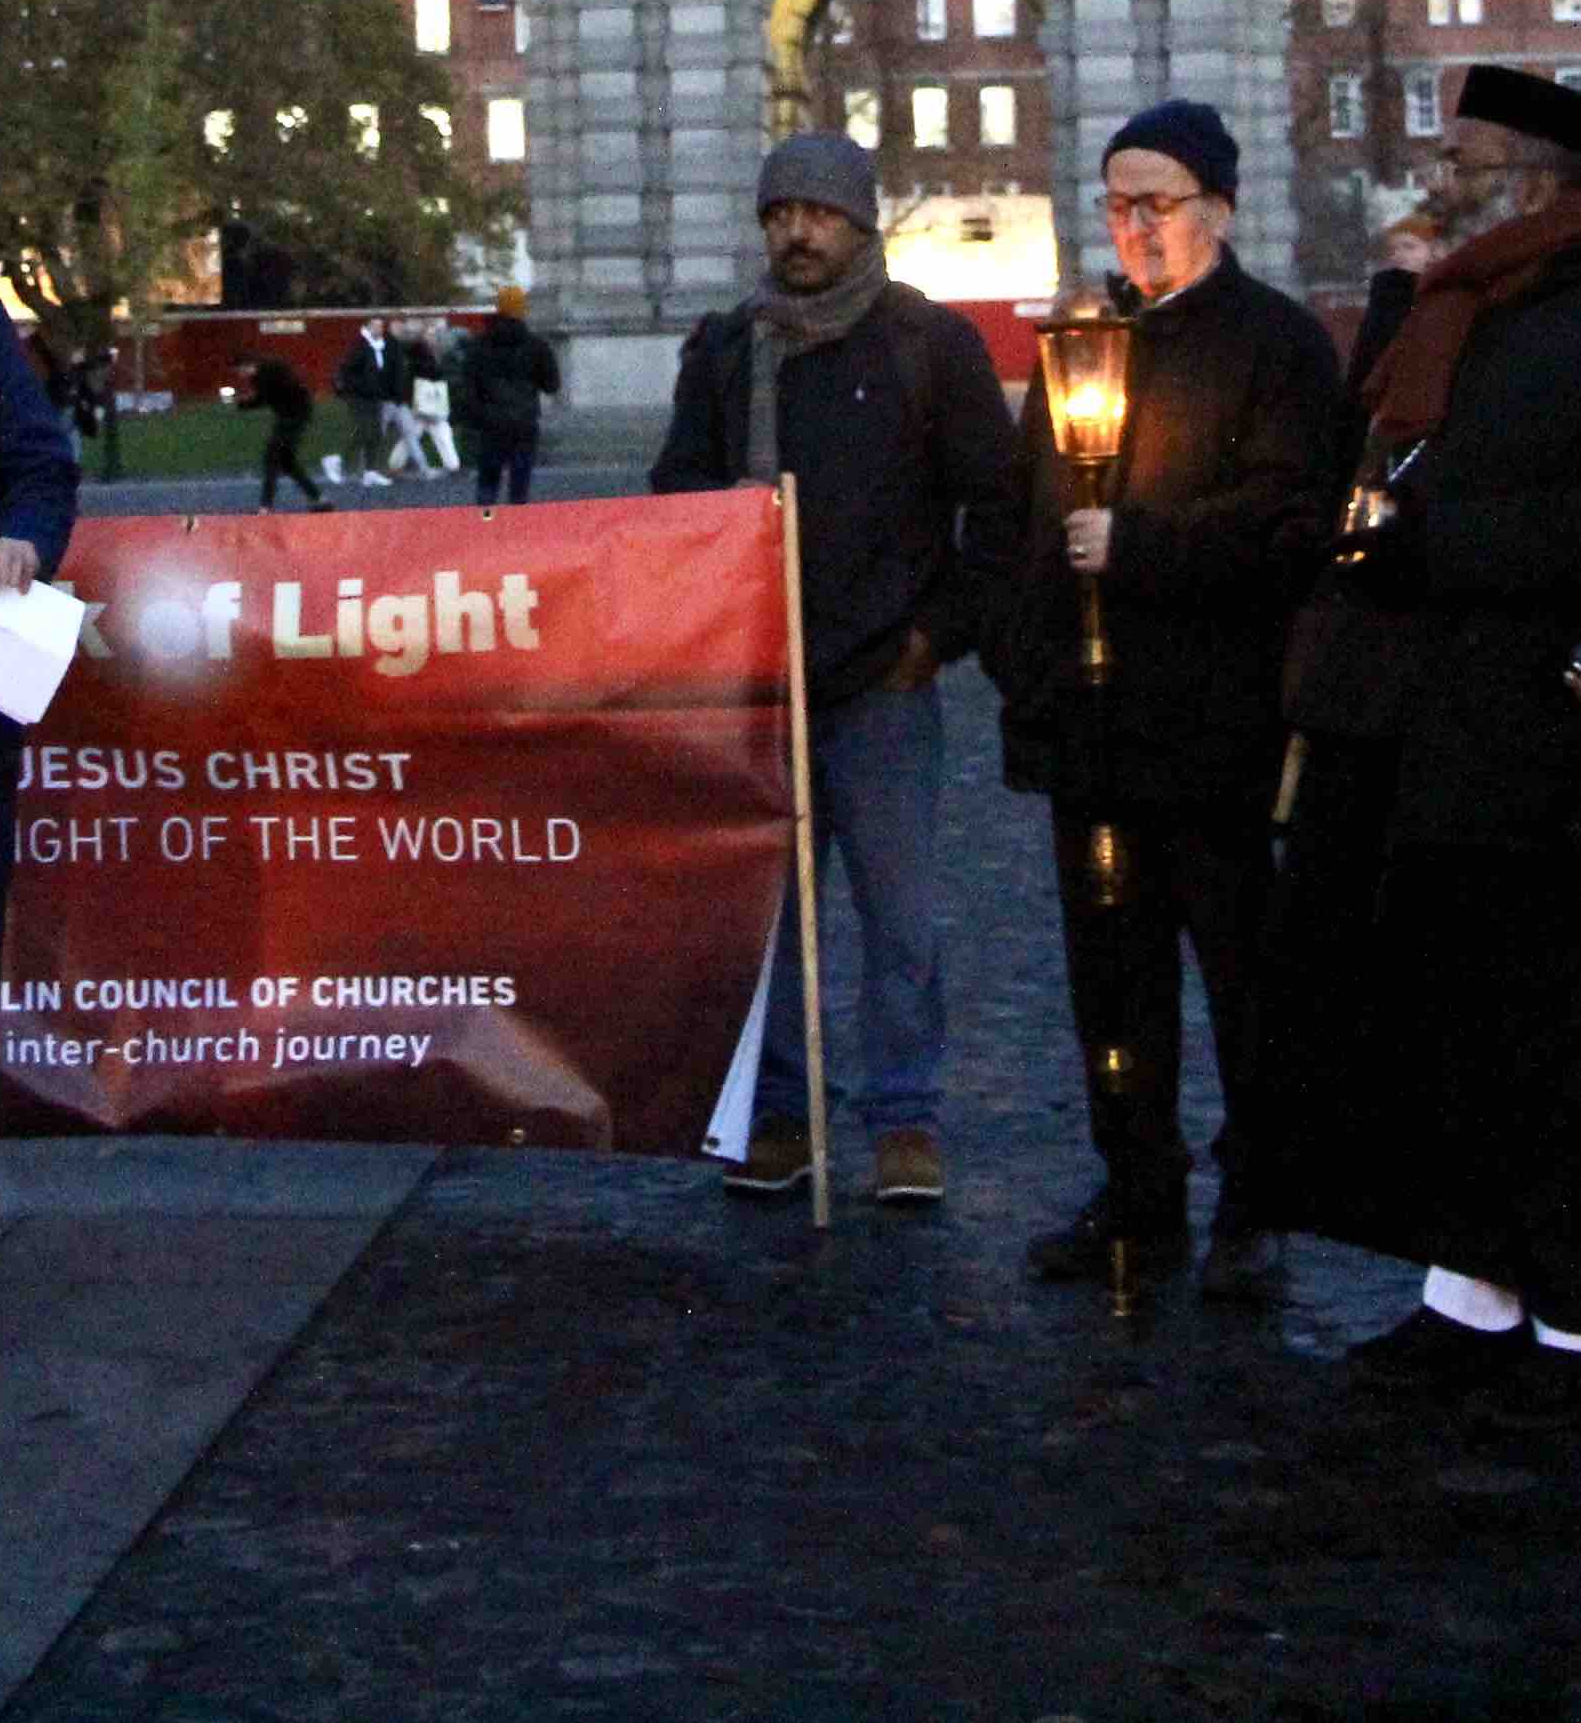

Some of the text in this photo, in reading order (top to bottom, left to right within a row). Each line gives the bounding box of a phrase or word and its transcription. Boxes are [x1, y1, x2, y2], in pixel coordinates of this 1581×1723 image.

[137, 581, 242, 660] of
[272, 571, 540, 676] Light
[16, 746, 411, 791] JESUS CHRIST
[160, 815, 230, 863] OF
[249, 816, 358, 862] THE
[377, 817, 581, 863] WORLD
[0, 975, 517, 1012] LIN COUNCIL OF CHURCHES
[5, 1027, 432, 1069] inter-church journey
